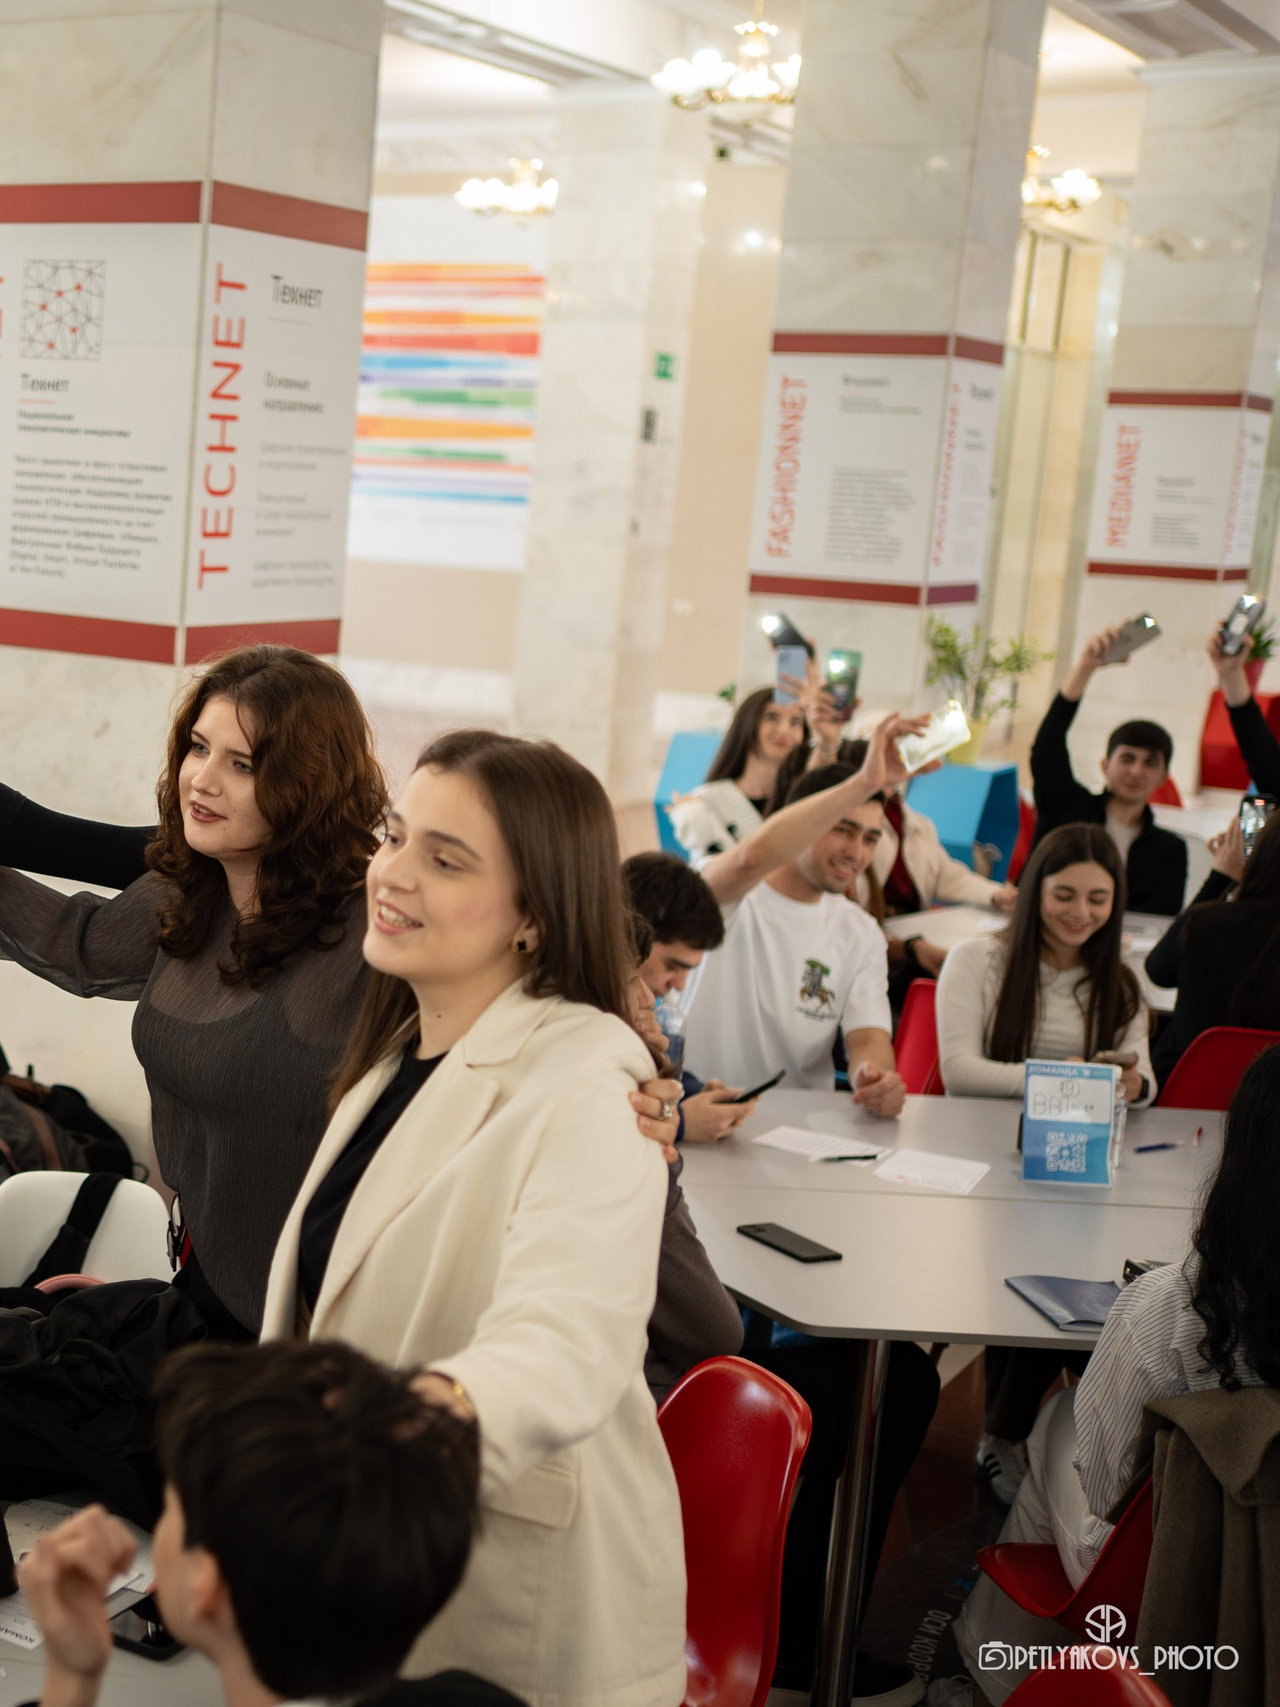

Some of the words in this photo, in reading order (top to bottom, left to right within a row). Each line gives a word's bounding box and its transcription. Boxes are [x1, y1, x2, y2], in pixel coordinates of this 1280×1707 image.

[271, 274, 324, 309] Технет
[21, 373, 70, 392] Технет
[198, 262, 248, 590] TECHNET
[766, 374, 809, 558] FASHIONNET
[1105, 423, 1143, 548] MEDIANET
[1029, 1065, 1079, 1077] КОМАНДА
